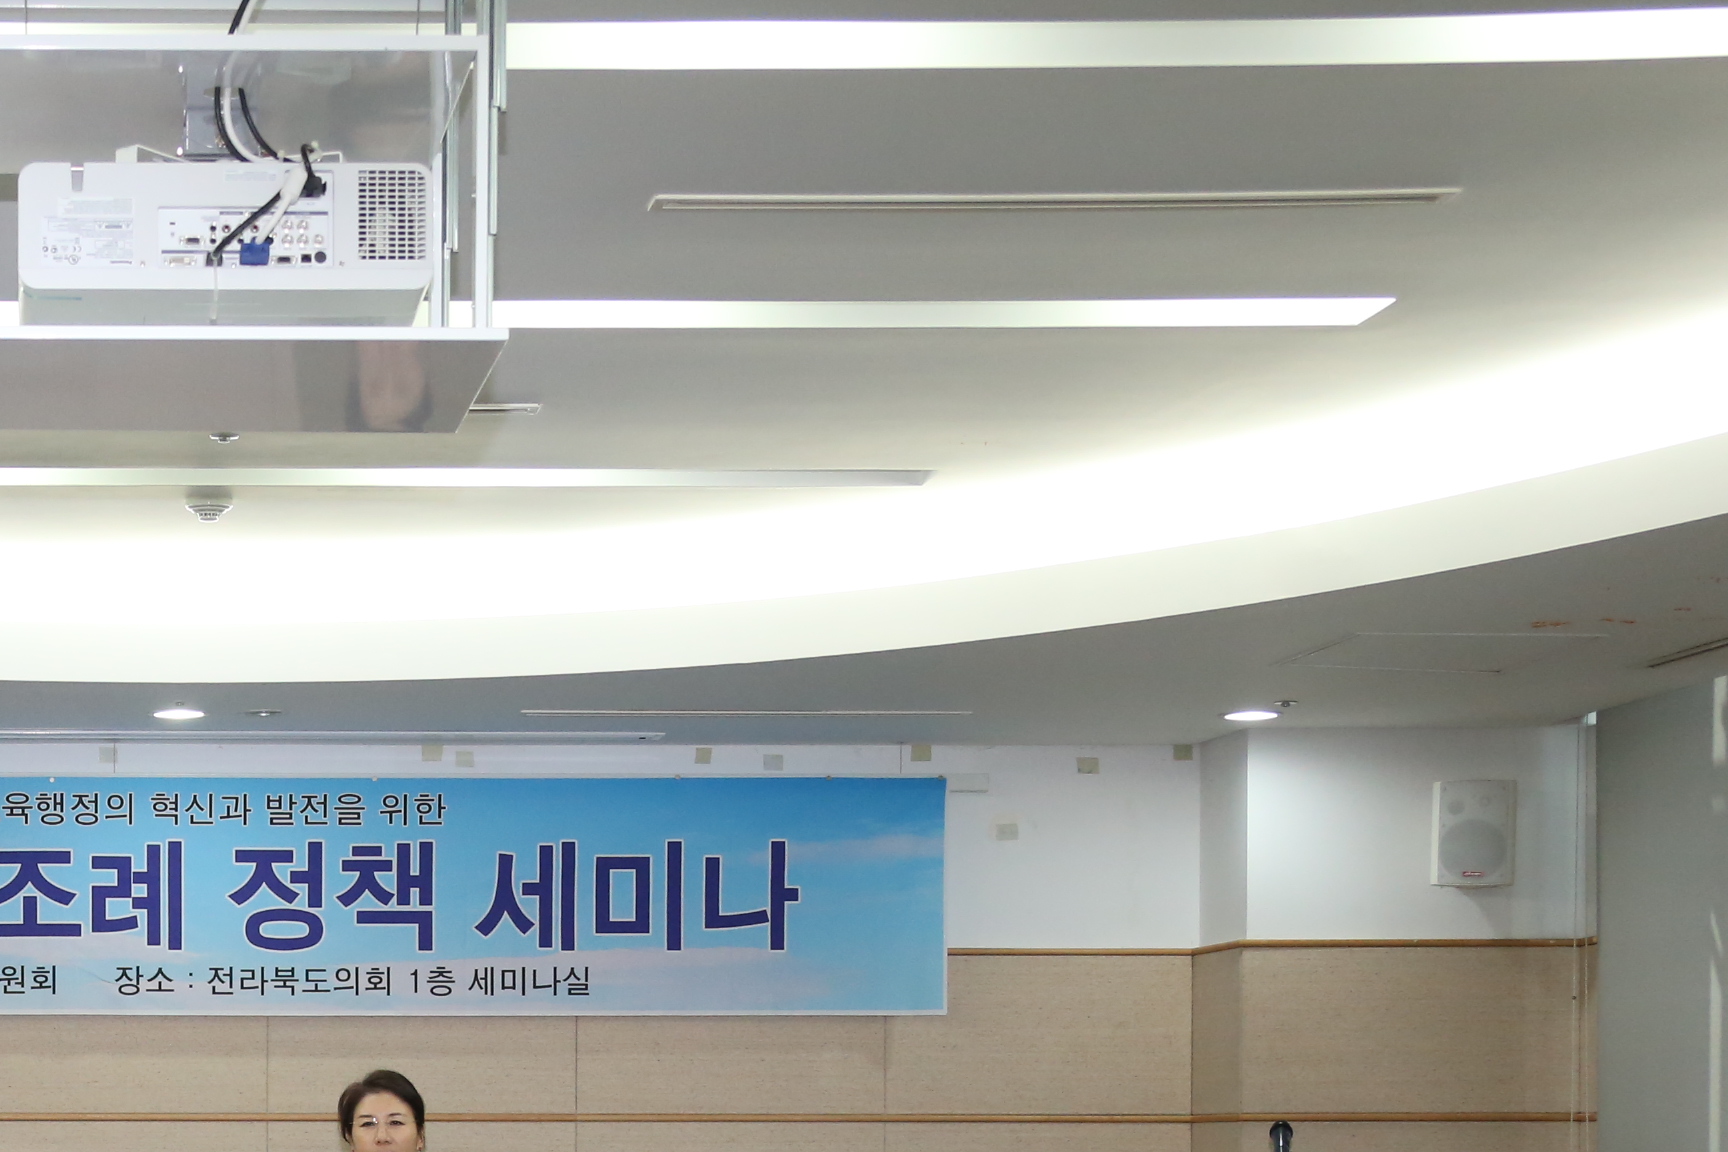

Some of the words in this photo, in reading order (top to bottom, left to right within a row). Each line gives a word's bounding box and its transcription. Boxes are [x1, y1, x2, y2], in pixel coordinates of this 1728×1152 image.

[150, 792, 252, 826] 혁신과
[266, 792, 366, 826] 발전을
[379, 792, 447, 826] 위한
[227, 840, 435, 952] 정책
[474, 840, 800, 952] 세미나
[114, 964, 175, 996] 장소
[207, 965, 391, 997] 전라북도의회
[410, 966, 456, 997] 1층
[468, 965, 590, 997] 세미나실
